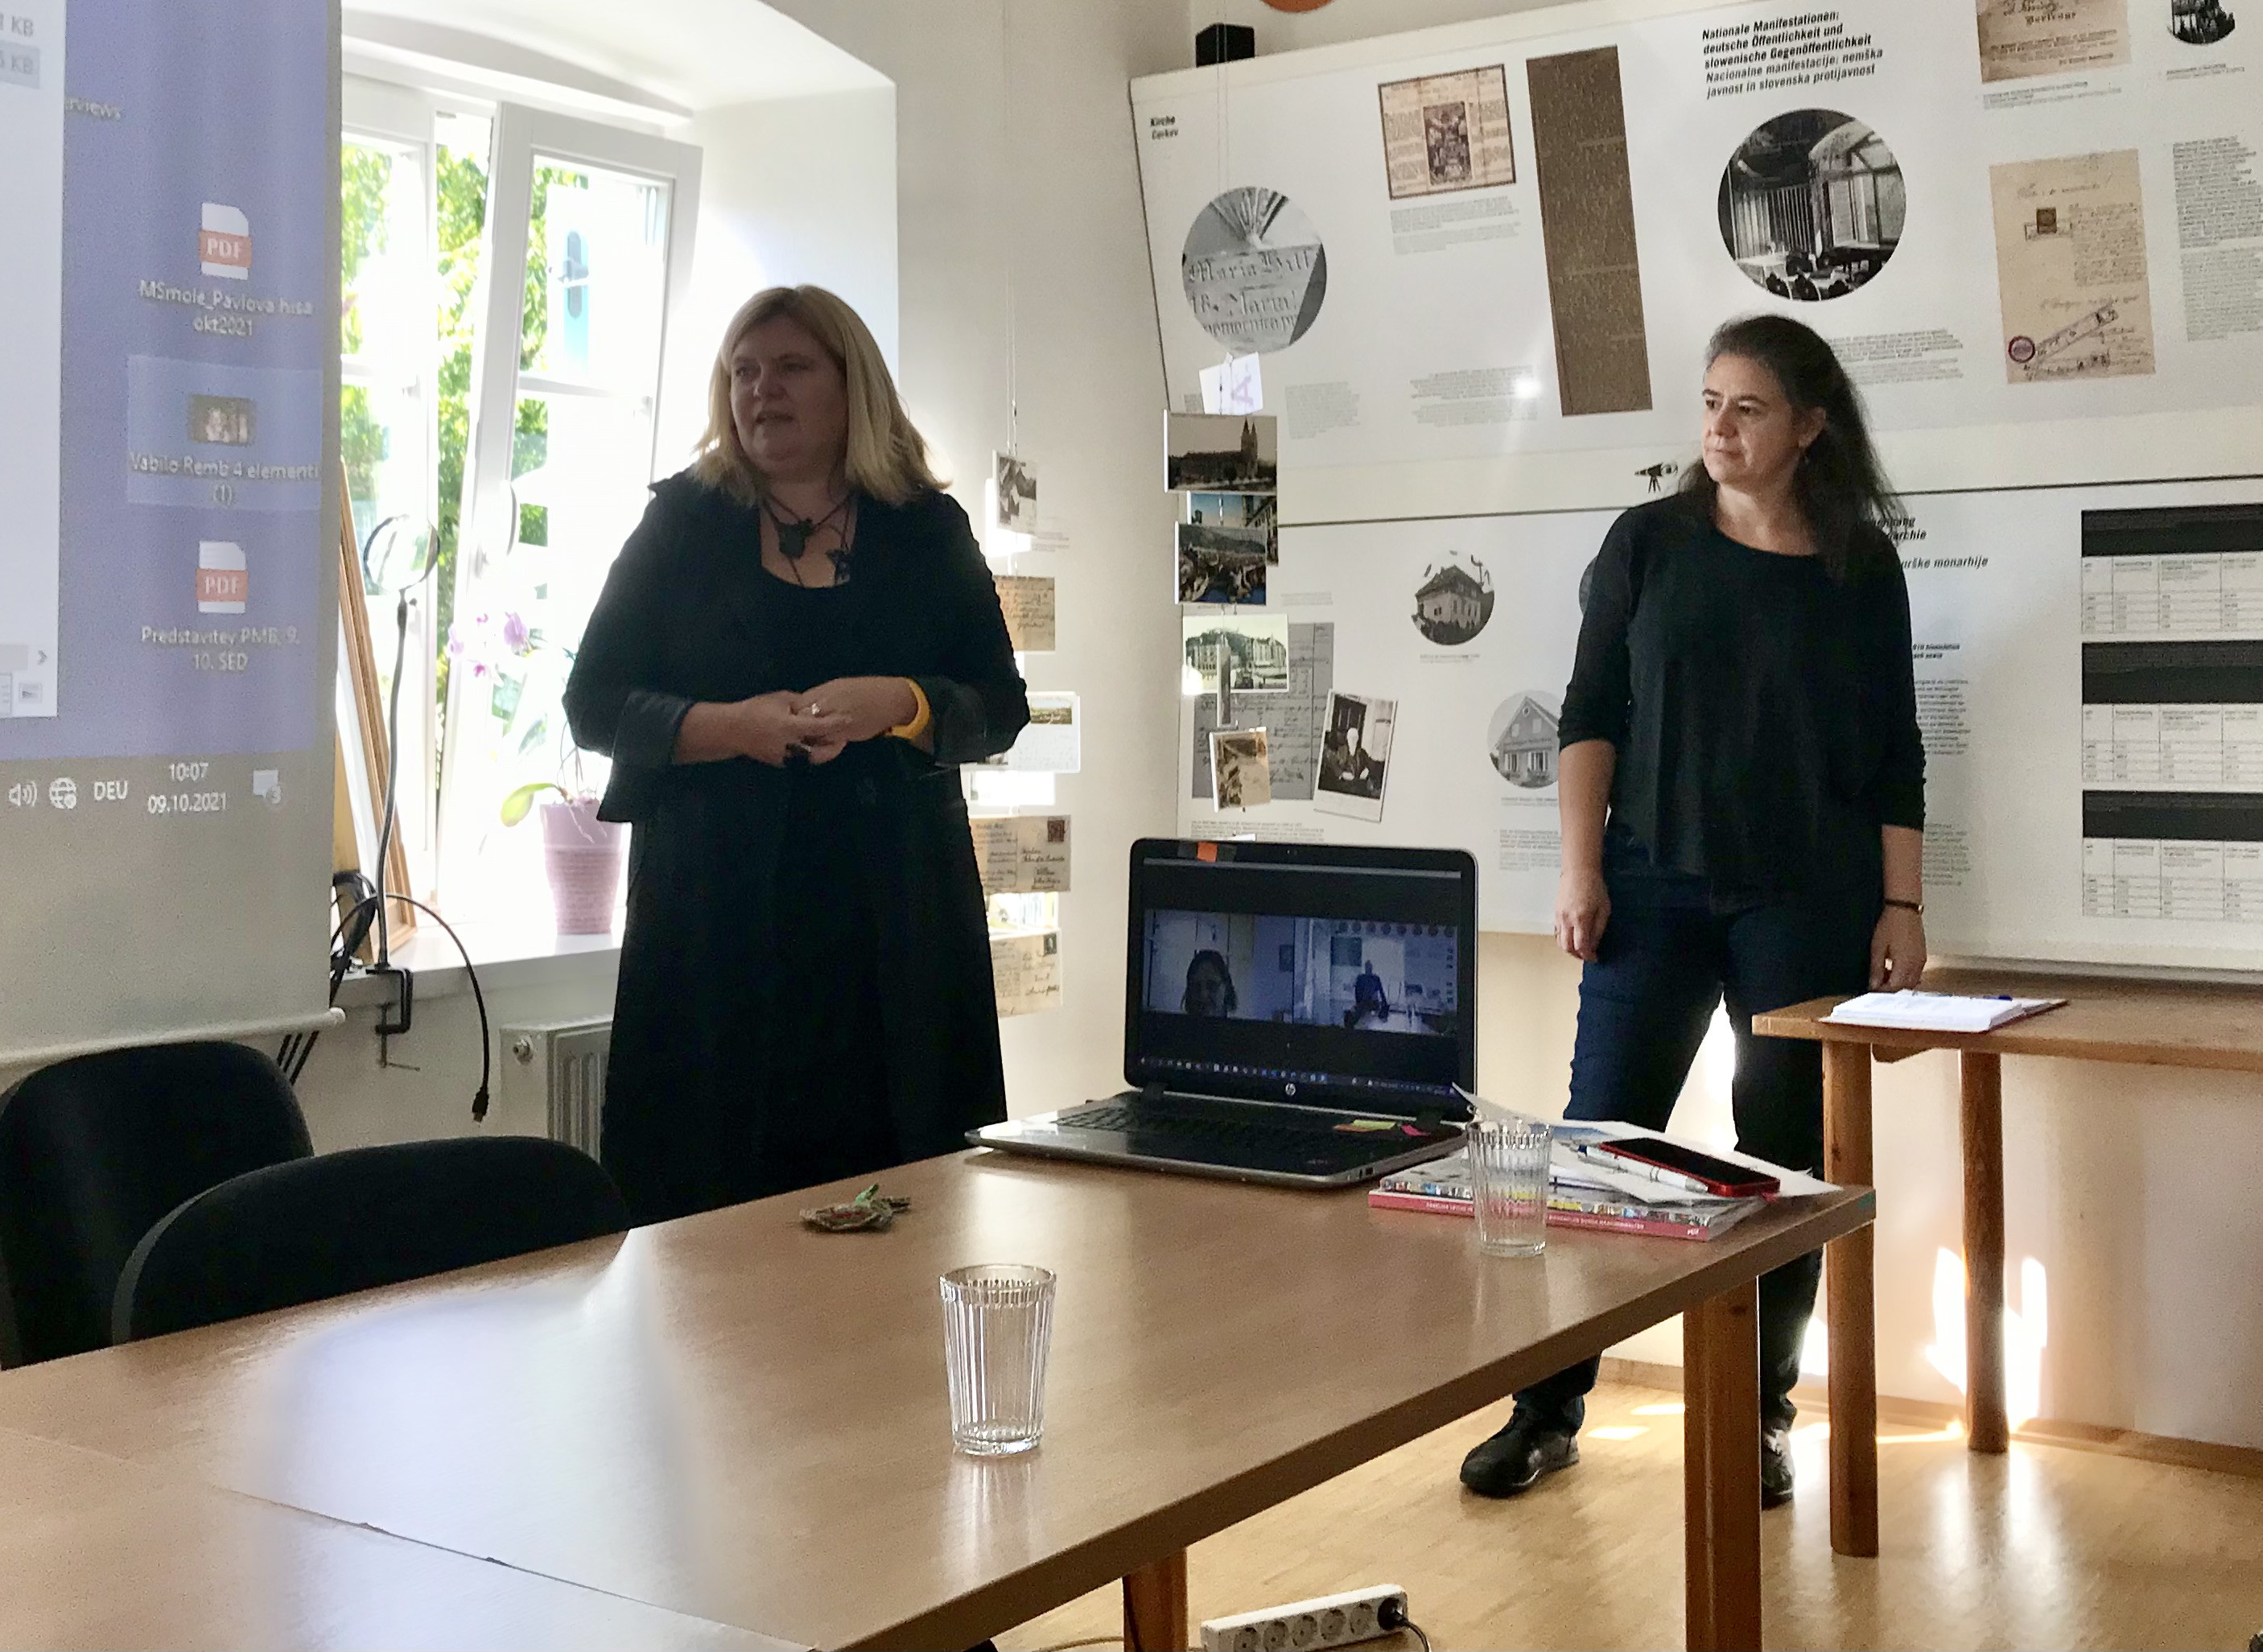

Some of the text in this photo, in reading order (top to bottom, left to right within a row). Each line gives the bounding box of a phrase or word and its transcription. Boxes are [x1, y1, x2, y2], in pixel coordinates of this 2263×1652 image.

[11, 16, 34, 37] KB
[1702, 23, 1750, 40] Nationale
[1703, 23, 1843, 55] deutsche Öffentlichkeit und
[1704, 33, 1871, 69] slowenische Gegenöffentlichkeit
[11, 54, 34, 75] KB
[1705, 67, 1762, 83] Nacionalne
[1842, 47, 1883, 64] nemška
[1705, 63, 1876, 100] javnost in slovenska protijavnost
[206, 237, 242, 258] PDF
[192, 315, 253, 336] okt2021
[183, 455, 229, 477] Remb
[233, 461, 242, 476] 4
[212, 483, 233, 506] (1)
[1934, 555, 1989, 570] monarhije
[204, 575, 240, 595] PDF
[195, 651, 249, 671] 10. SED
[169, 762, 209, 781] 10:07
[93, 781, 129, 801] DEU
[147, 792, 227, 814] 09.10.2021
